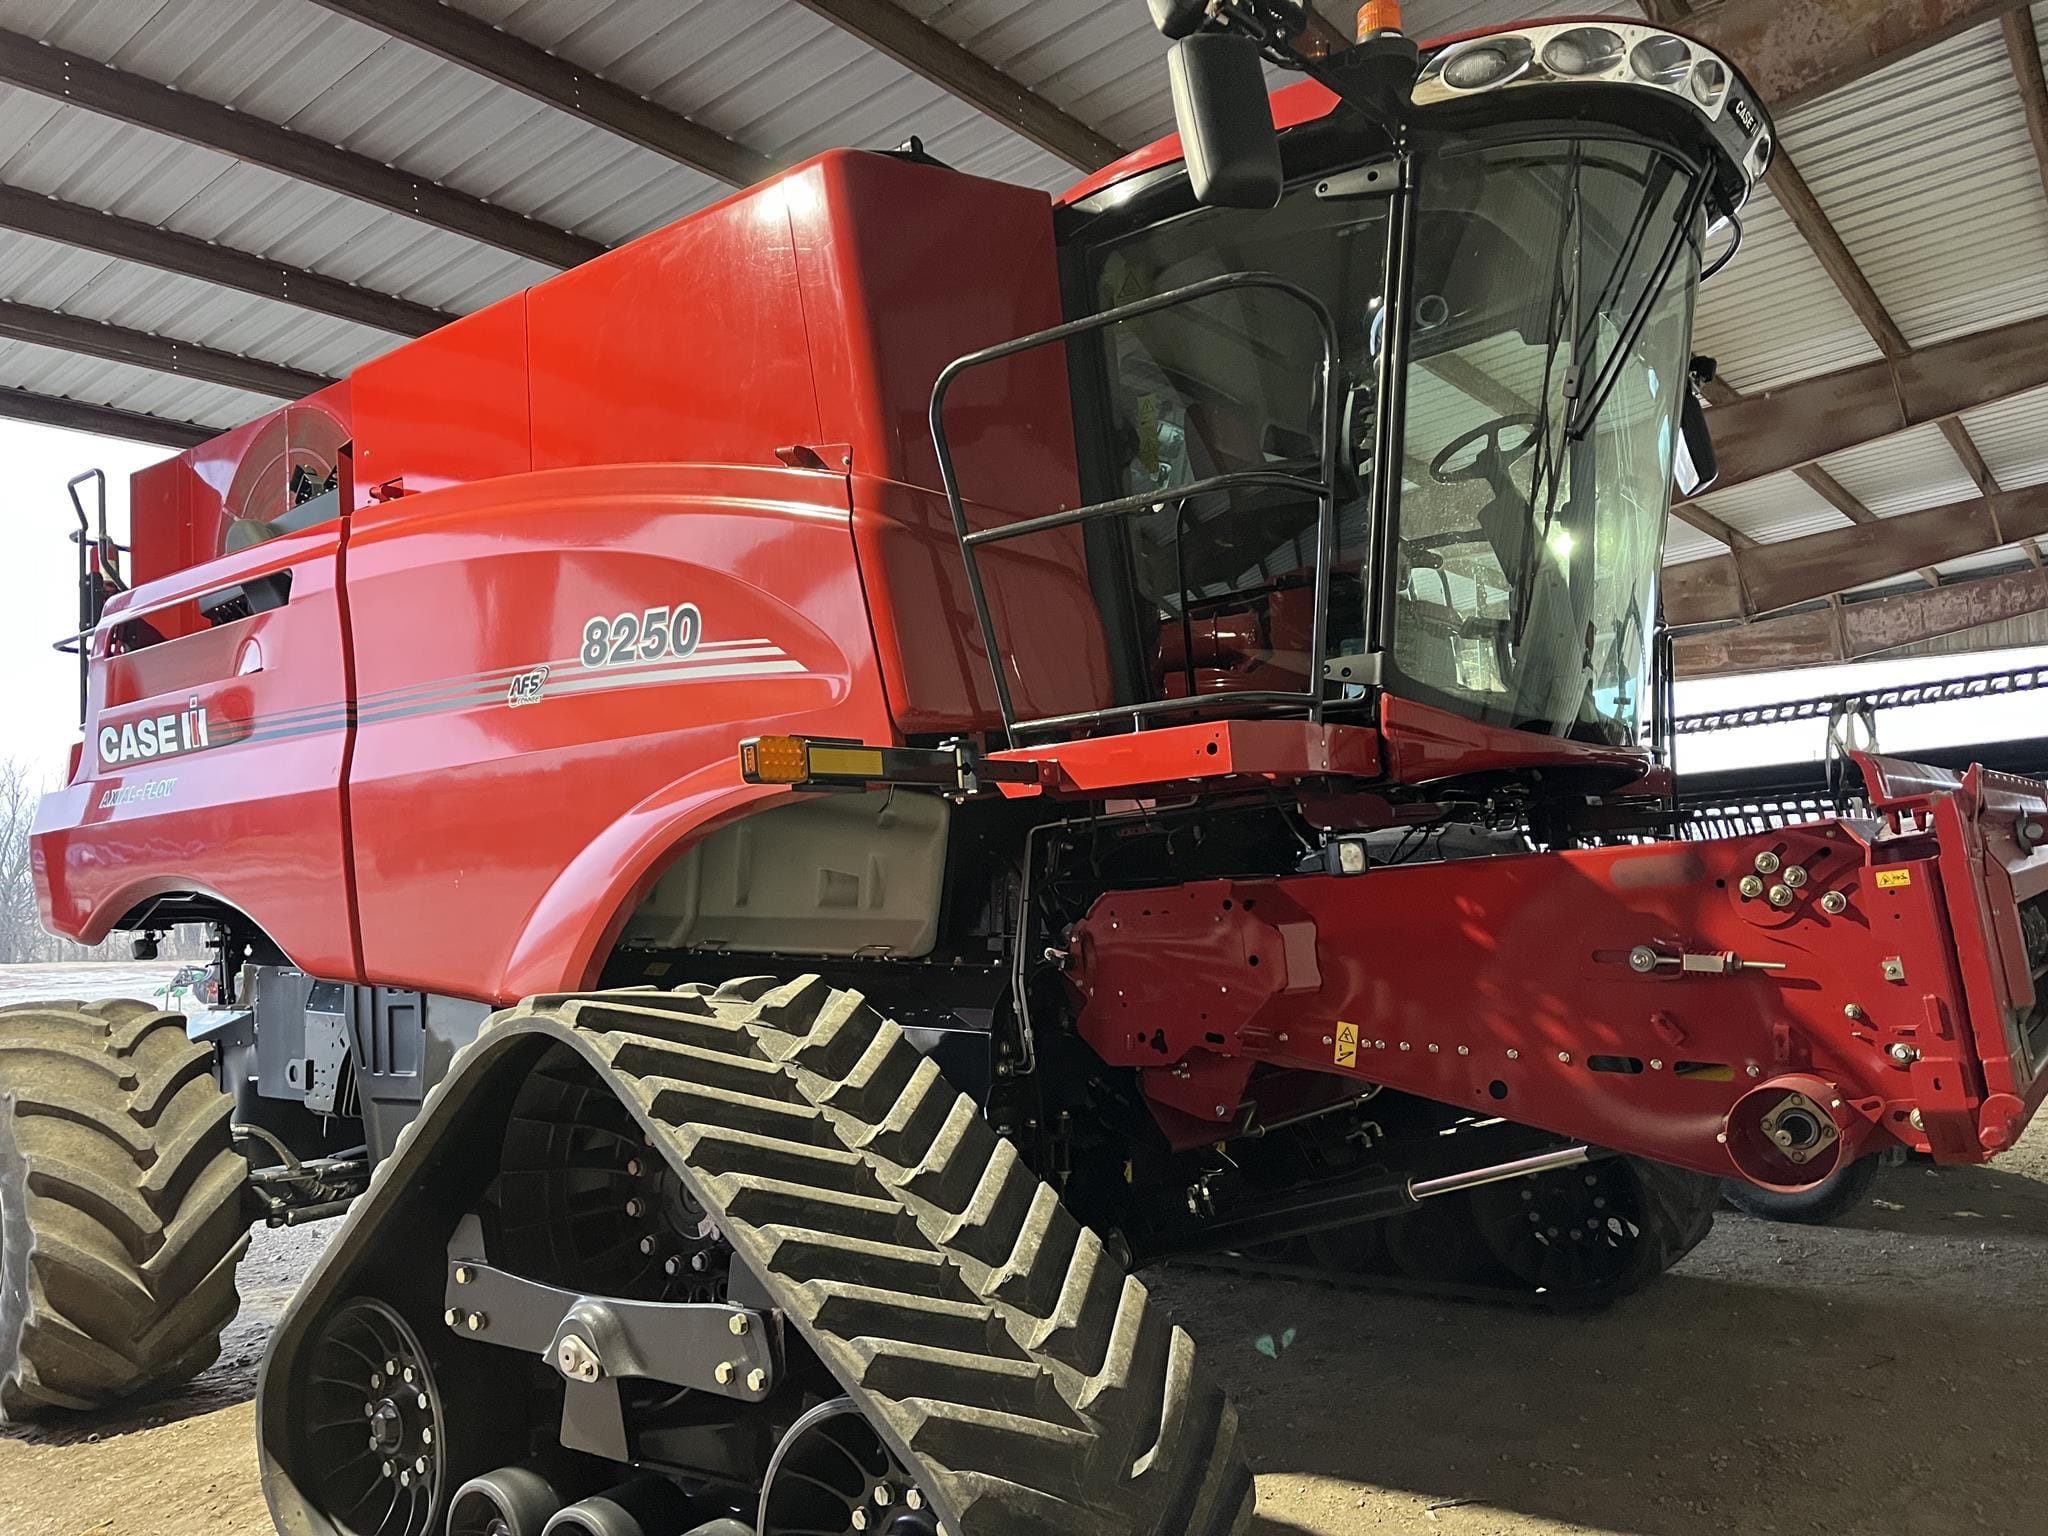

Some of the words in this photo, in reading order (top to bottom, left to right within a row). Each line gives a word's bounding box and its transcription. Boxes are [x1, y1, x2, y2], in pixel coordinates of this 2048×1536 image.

[1735, 100, 1754, 129] CASE
[581, 602, 701, 668] 8250
[508, 673, 542, 697] AFS
[100, 714, 178, 763] CASE
[99, 777, 178, 808] AXIAL-FLOW
